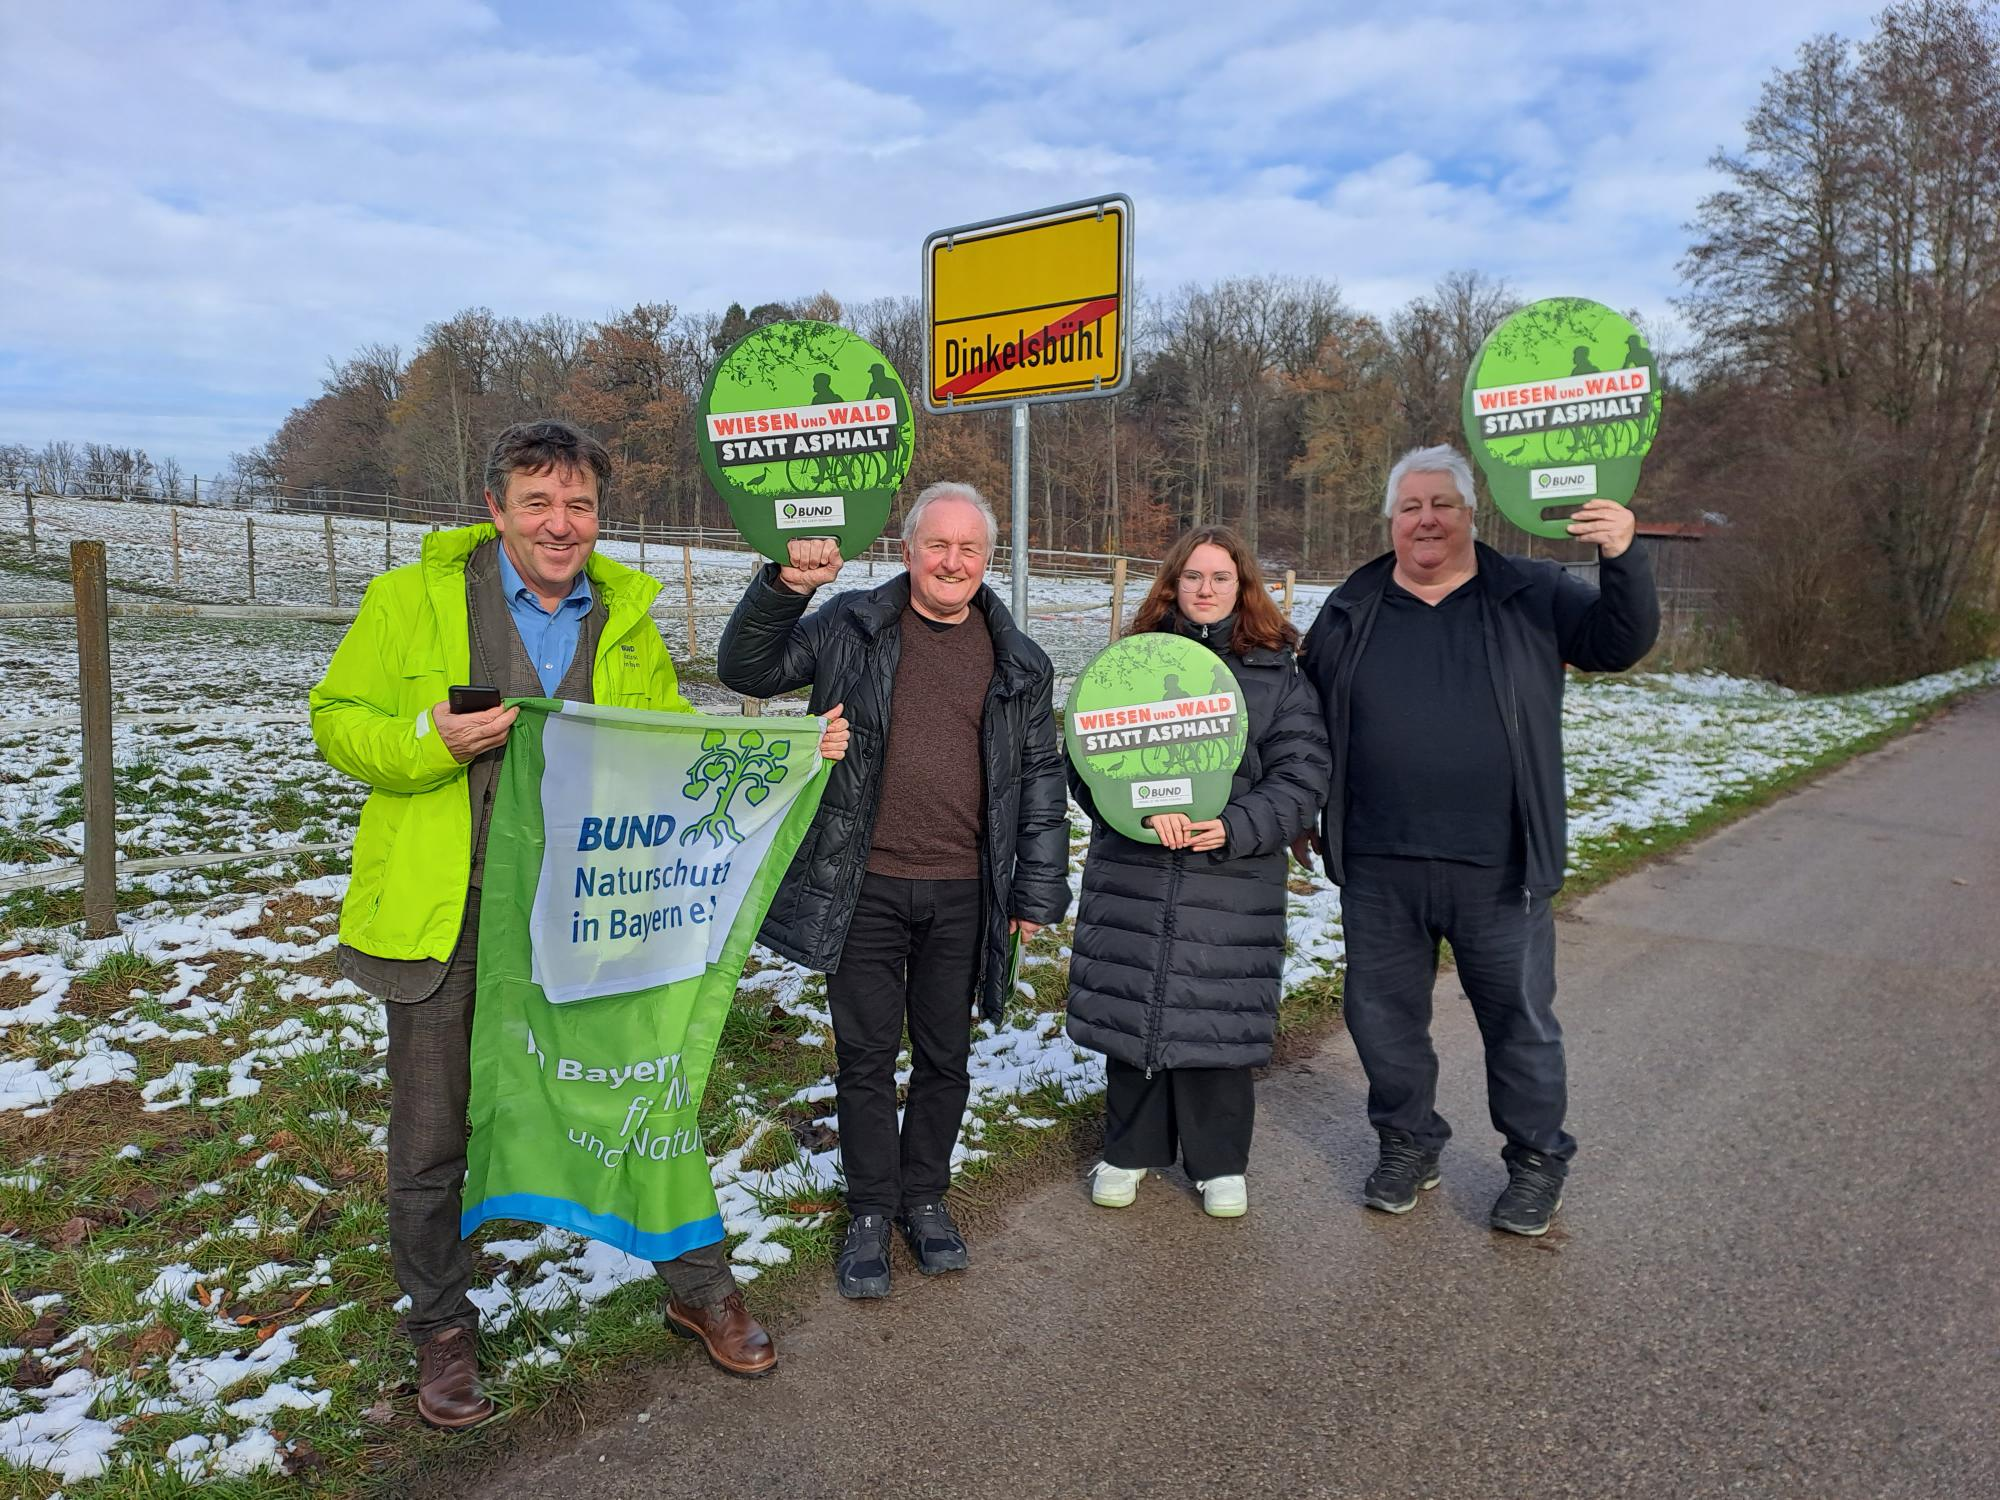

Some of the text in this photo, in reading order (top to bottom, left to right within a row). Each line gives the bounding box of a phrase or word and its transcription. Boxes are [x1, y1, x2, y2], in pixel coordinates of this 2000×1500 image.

[945, 318, 1103, 378] Dinkelsbühl
[1480, 373, 1645, 410] WIESEN UND WALD
[713, 404, 891, 436] WIESEN UND WALD
[1485, 396, 1643, 434] STATT ASPHALT
[722, 428, 890, 461] STATT ASPHALT
[1553, 475, 1585, 486] BUND
[798, 506, 833, 517] BUND
[1079, 697, 1232, 731] WIESEN UND WALD
[1086, 717, 1231, 751] STATT ASPHALT
[1151, 787, 1182, 797] BUND
[577, 814, 676, 852] BUND
[572, 911, 599, 943] in
[610, 904, 683, 943] Bayern
[627, 1125, 703, 1160] Natu
